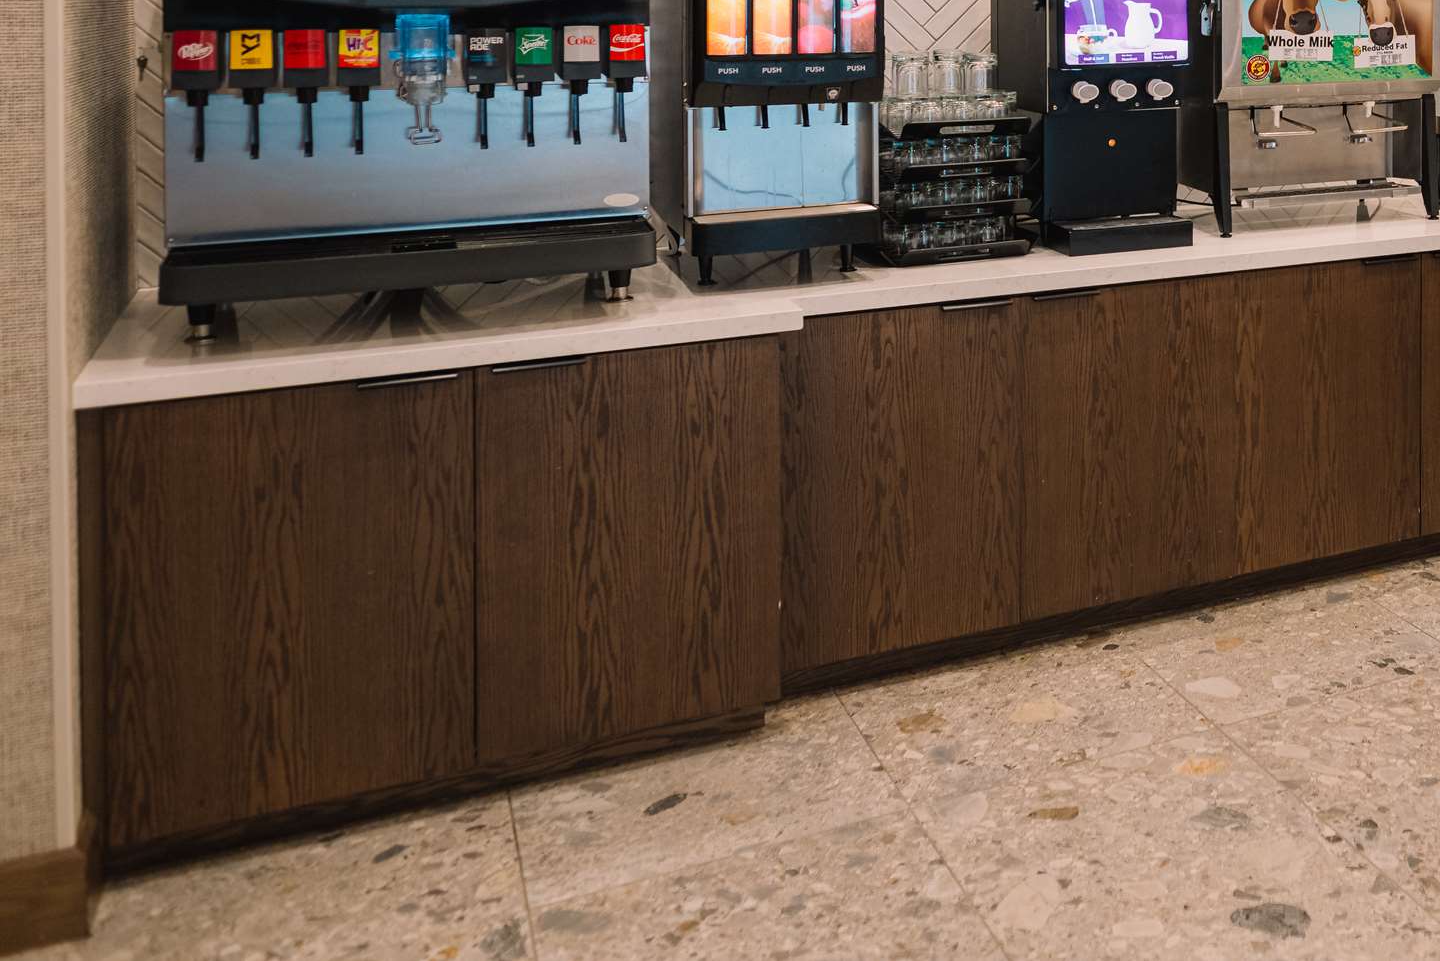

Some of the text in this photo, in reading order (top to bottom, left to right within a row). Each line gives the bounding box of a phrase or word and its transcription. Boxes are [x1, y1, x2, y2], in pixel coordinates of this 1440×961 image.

[470, 36, 504, 44] POWER
[567, 35, 597, 46] Coke
[1268, 35, 1334, 48] Whole Milk
[1395, 42, 1408, 50] Fat
[718, 67, 739, 75] PUSH
[762, 66, 782, 74] PUSH
[805, 65, 825, 73] PUSH
[846, 64, 866, 72] PUSH
